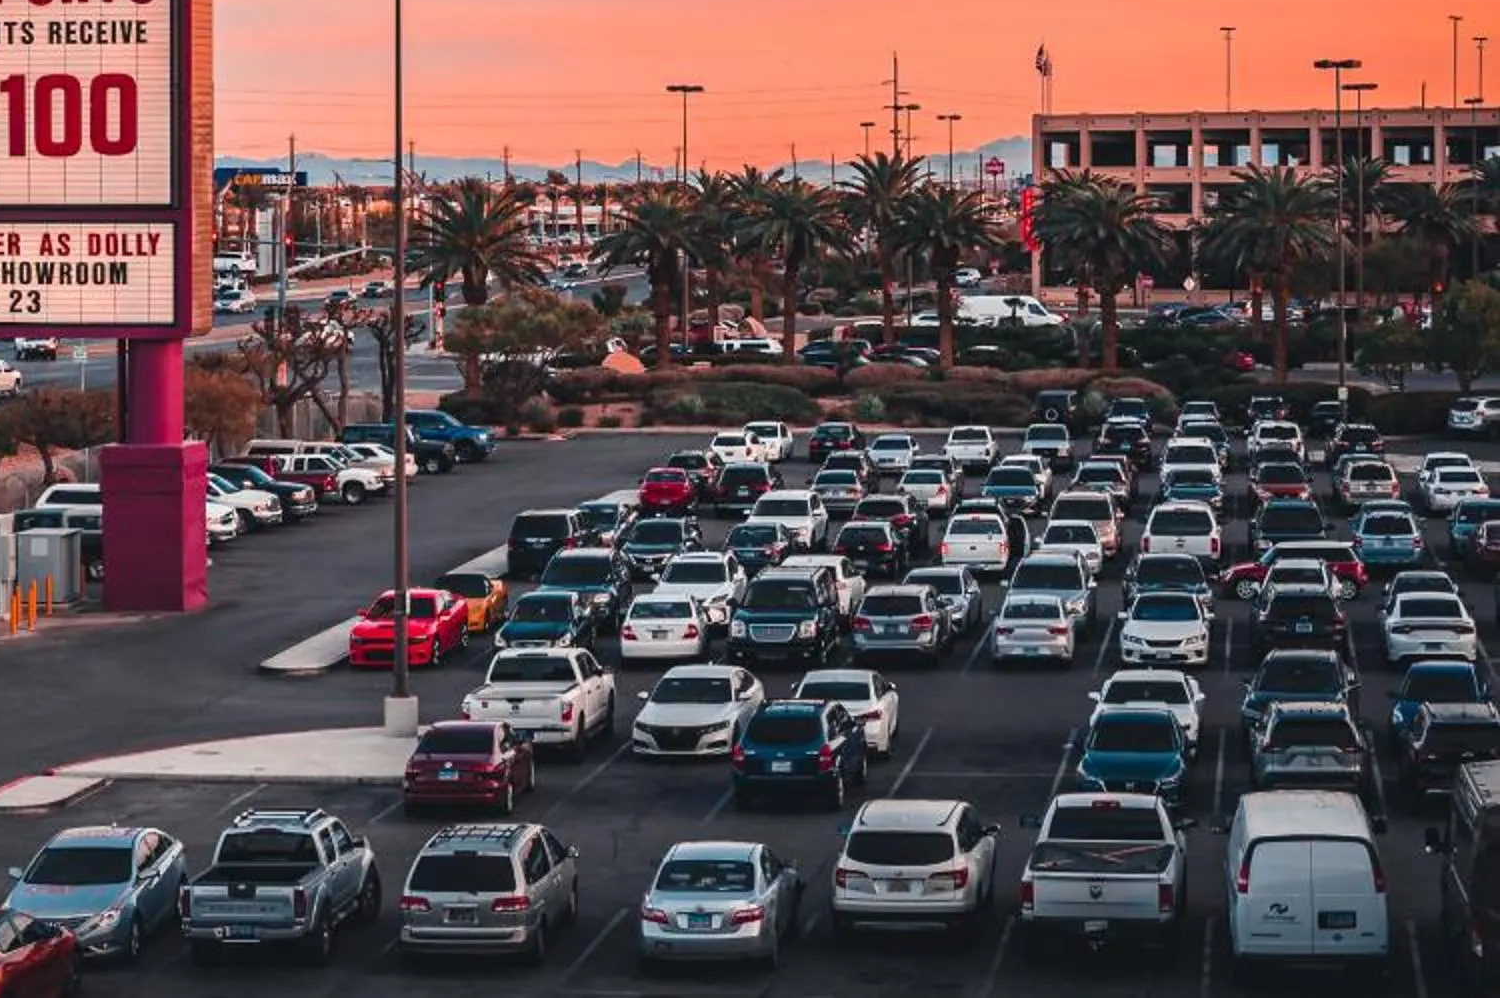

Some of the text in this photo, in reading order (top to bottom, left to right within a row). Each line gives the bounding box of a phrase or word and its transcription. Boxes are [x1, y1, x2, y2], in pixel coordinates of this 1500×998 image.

[48, 20, 148, 44] RECEIVE
[39, 232, 71, 256] AS
[87, 232, 161, 256] DOLLY
[8, 289, 42, 314] 23
